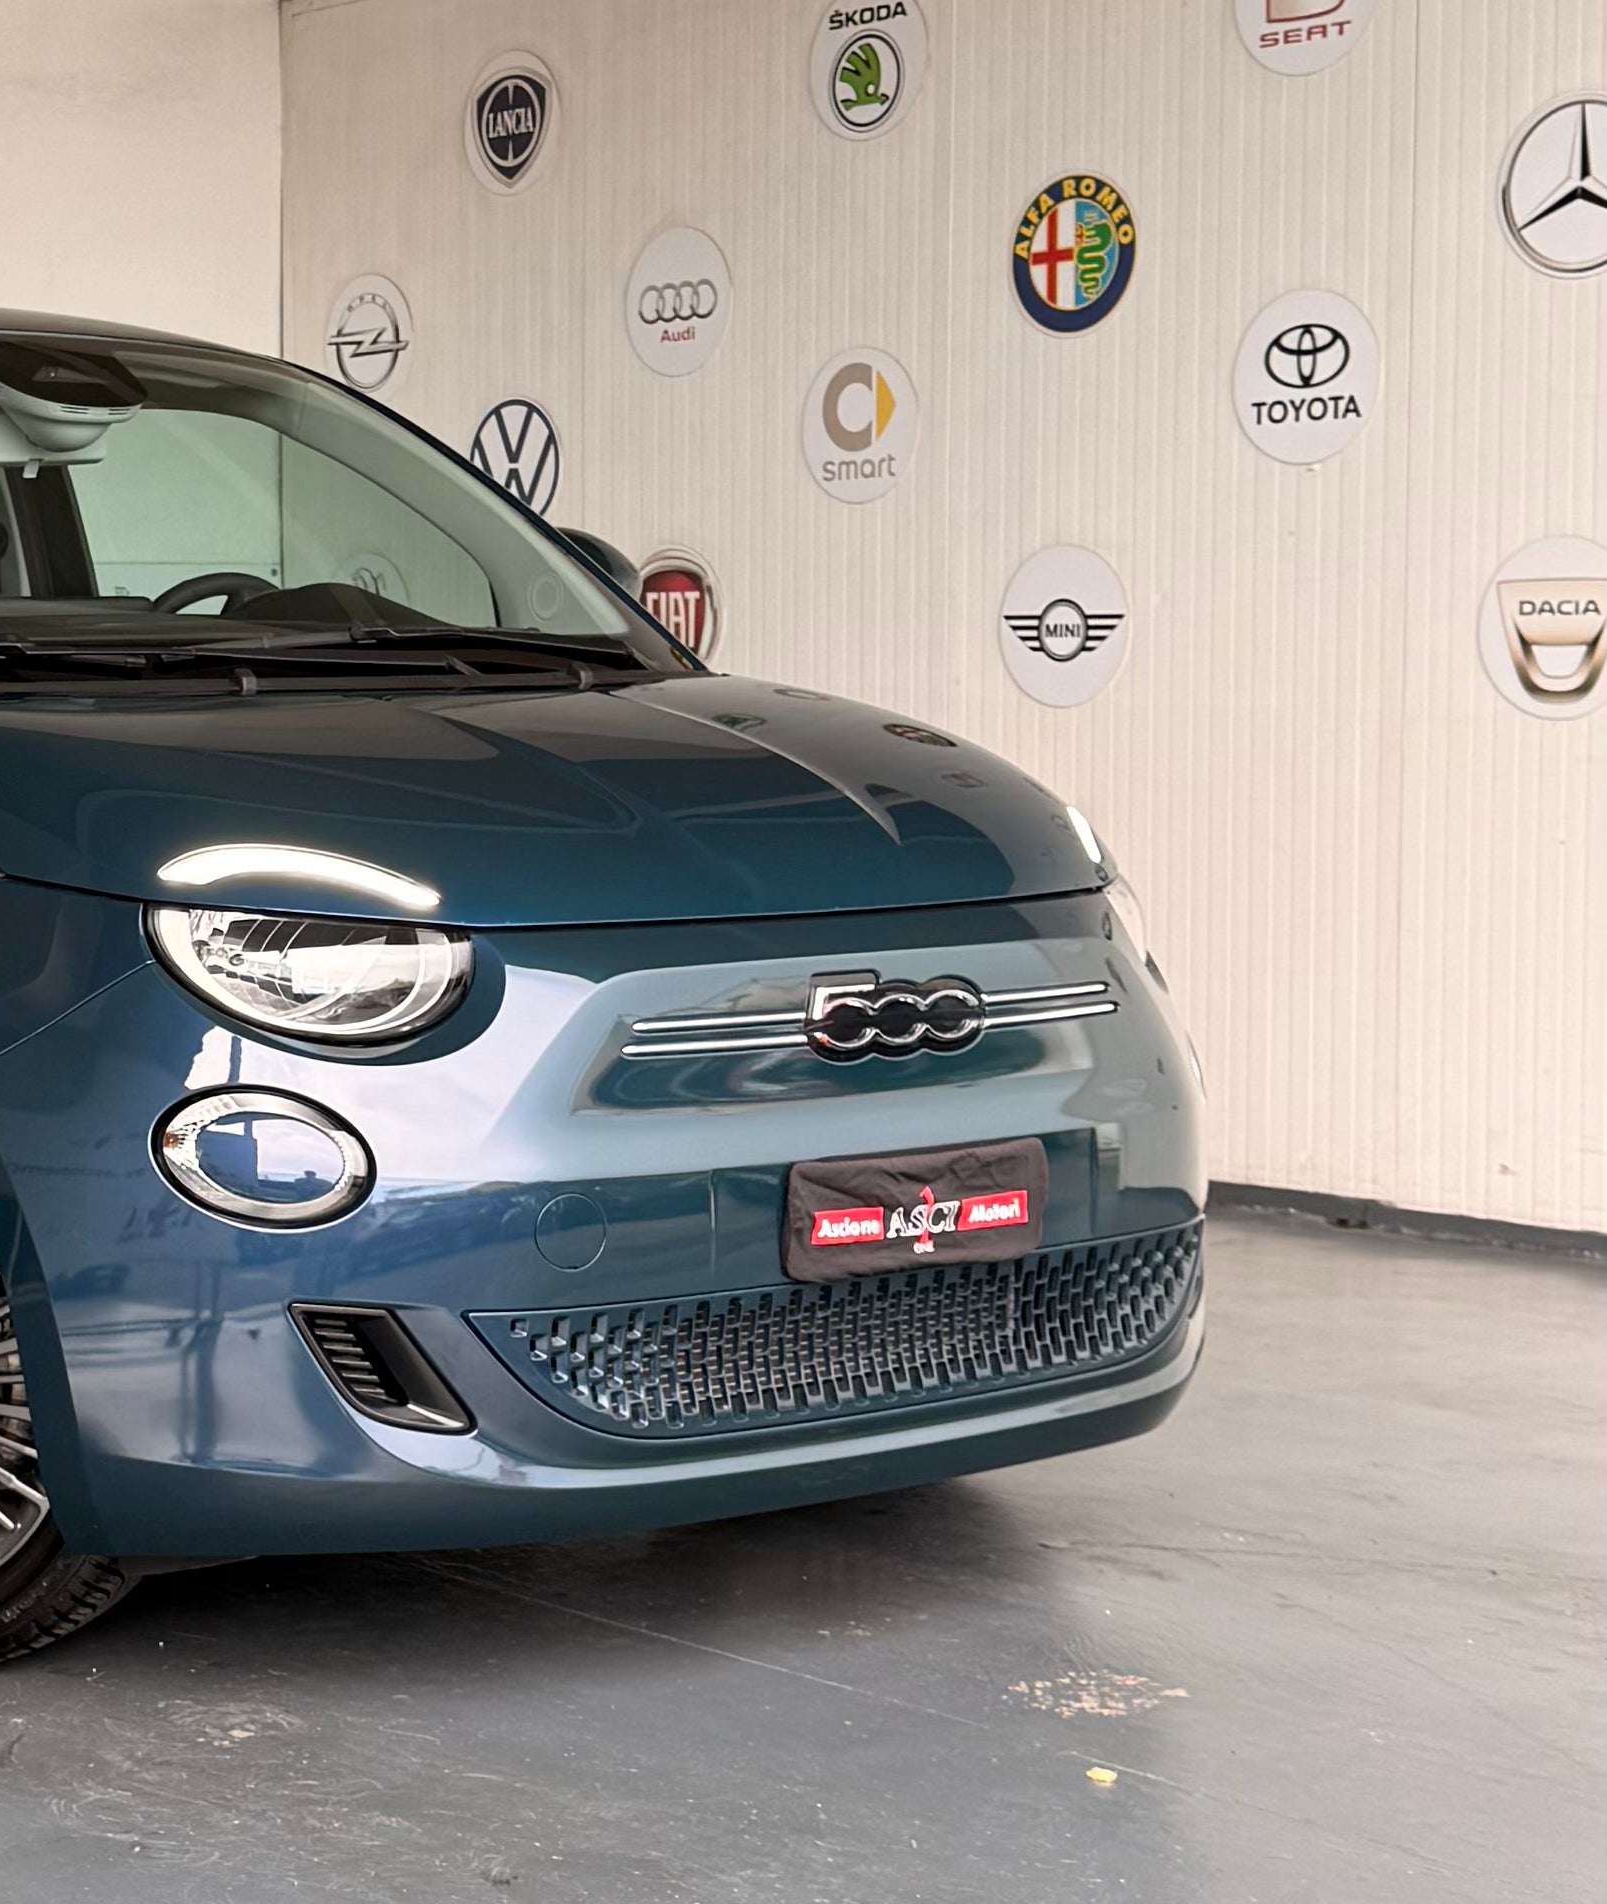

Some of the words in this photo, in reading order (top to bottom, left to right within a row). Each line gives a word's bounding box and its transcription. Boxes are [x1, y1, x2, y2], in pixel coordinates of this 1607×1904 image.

[829, 1, 907, 30] ŠKODA
[1259, 20, 1352, 48] SEAT
[489, 107, 534, 138] LANCIA
[1014, 193, 1055, 259] ALFA
[1063, 178, 1133, 245] ROMEO
[661, 326, 695, 343] Audi
[1251, 395, 1362, 425] TOYOTA
[823, 453, 896, 482] smart
[1519, 599, 1601, 616] DACIA
[1045, 624, 1080, 638] MINI
[808, 976, 984, 1058] 500
[818, 1216, 881, 1238] Ascione
[886, 1200, 961, 1238] ASCI
[969, 1198, 1020, 1222] Motori
